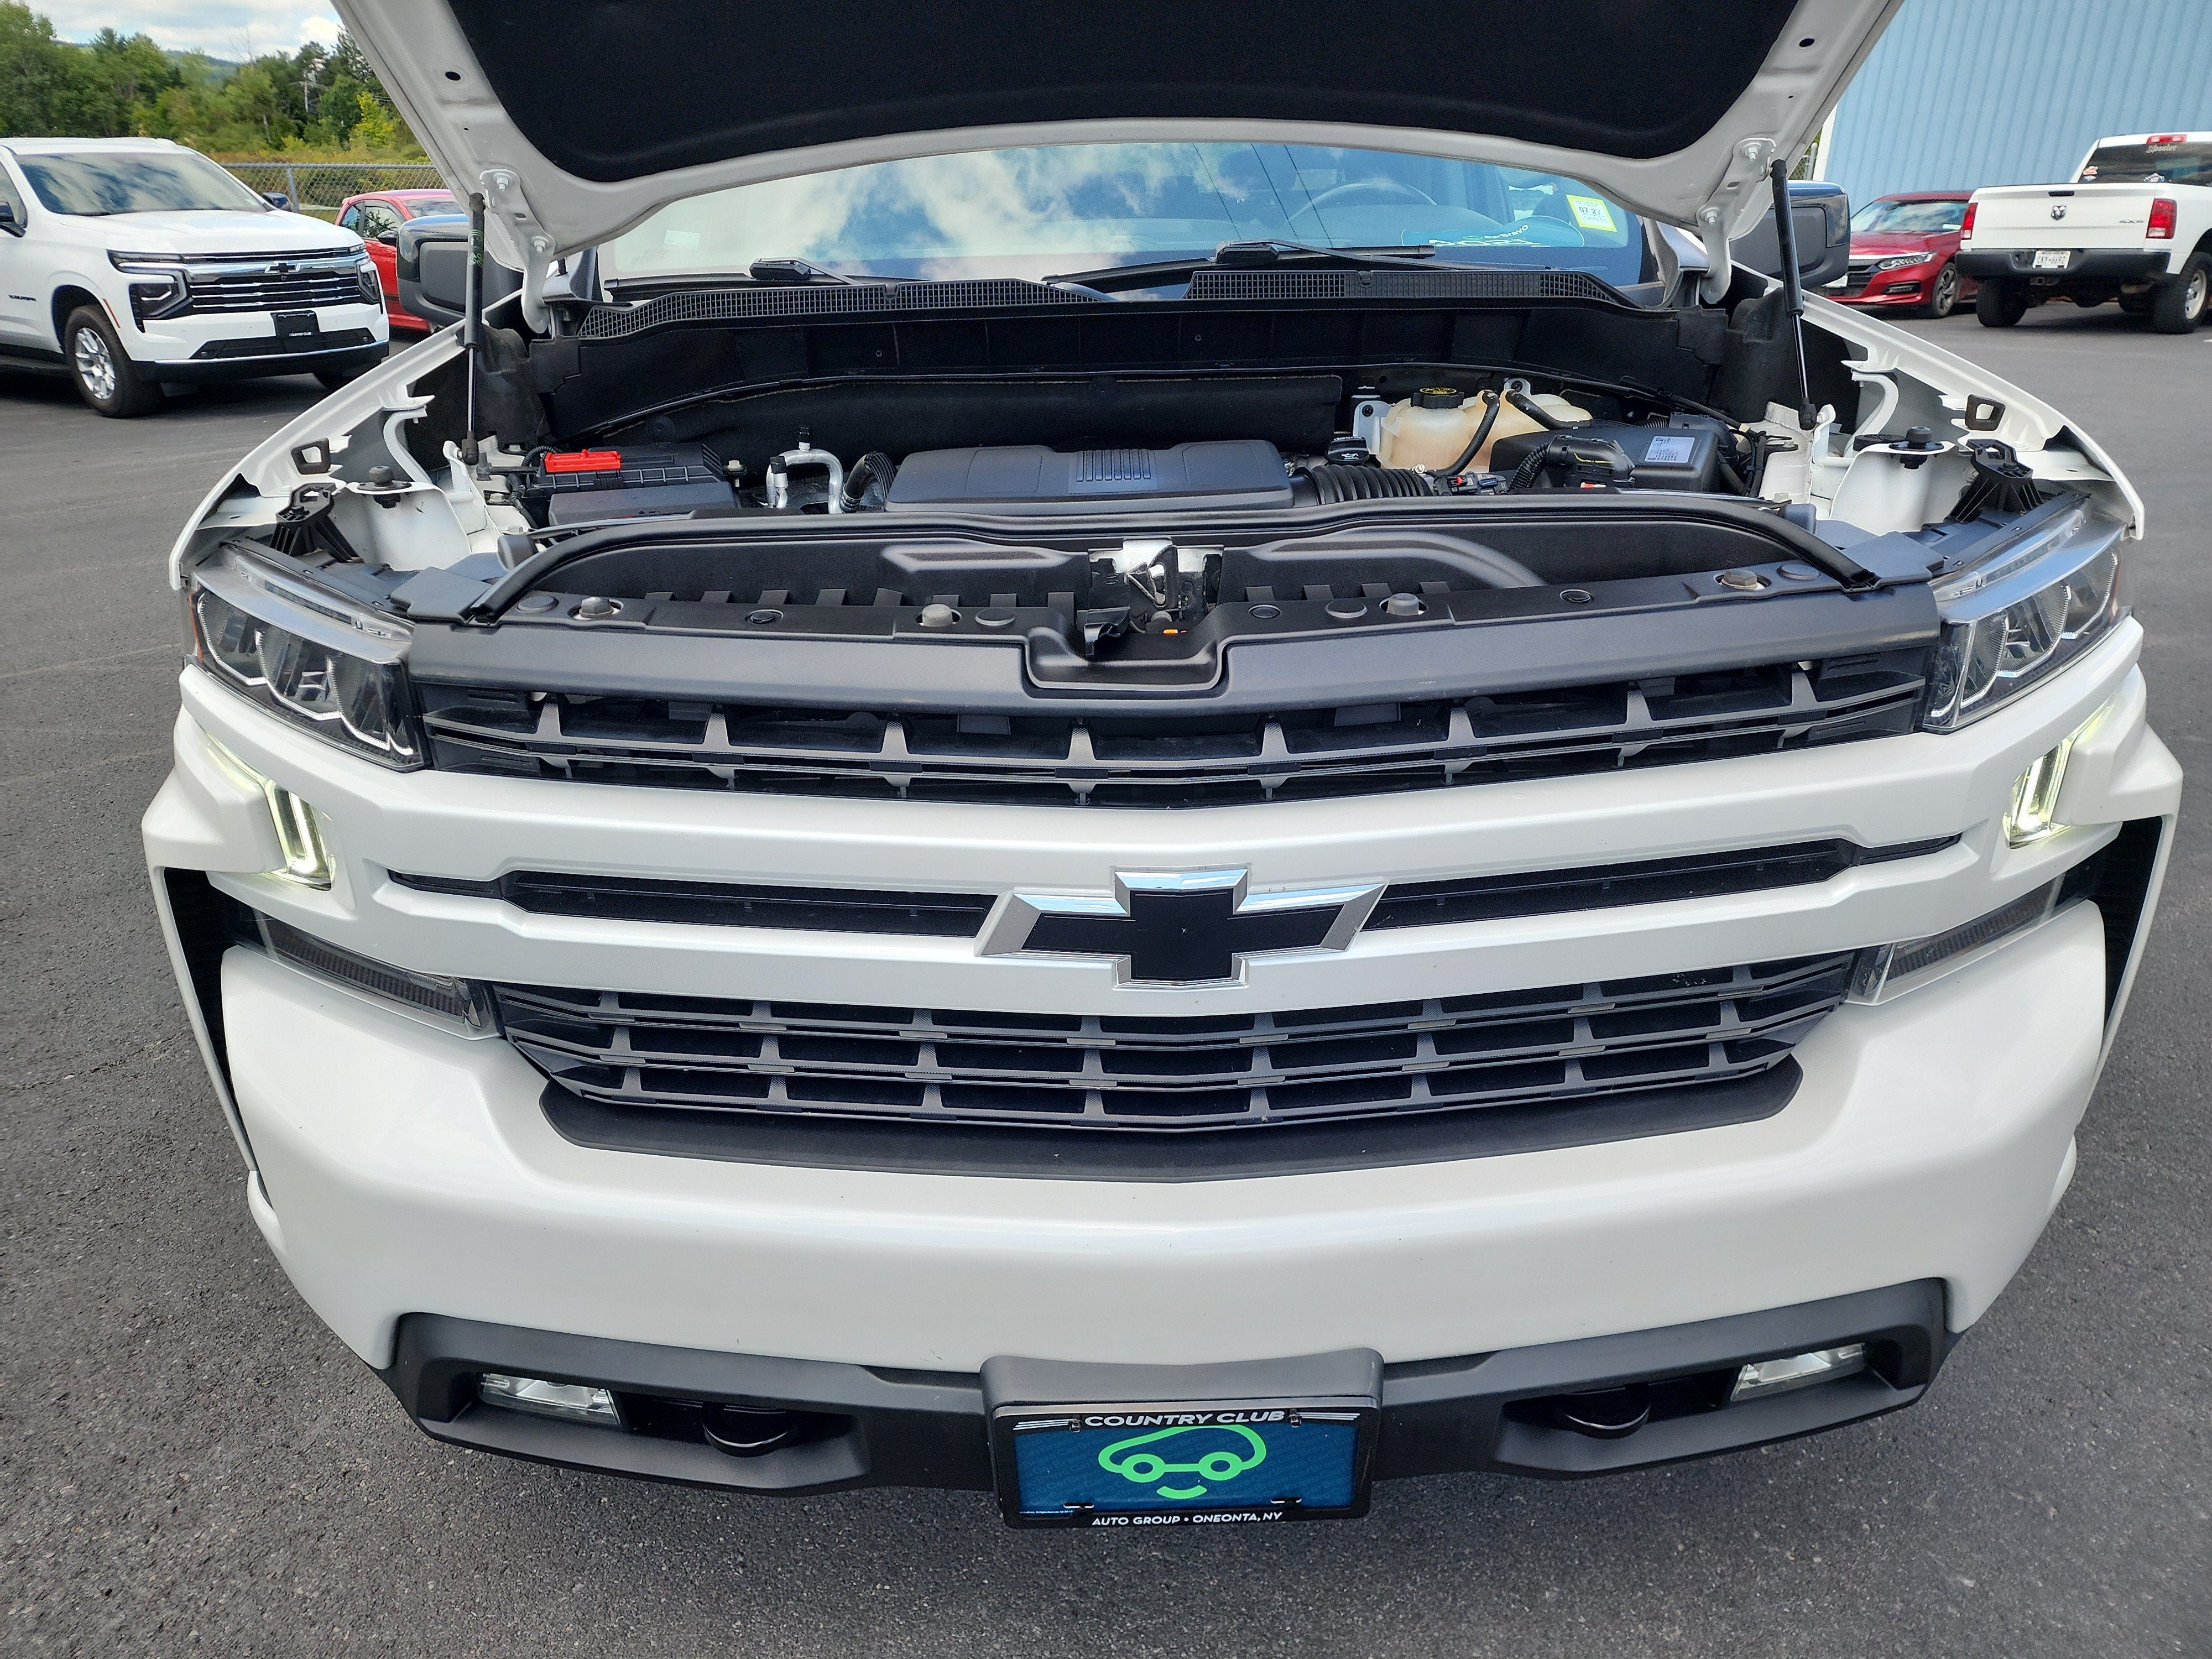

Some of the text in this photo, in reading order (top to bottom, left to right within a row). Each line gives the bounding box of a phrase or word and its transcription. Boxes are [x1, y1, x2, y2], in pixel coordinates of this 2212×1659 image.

[1084, 1411, 1285, 1426] COUNTRY CLUB
[1092, 1516, 1129, 1526] AUTO
[1133, 1516, 1180, 1525] GROUP
